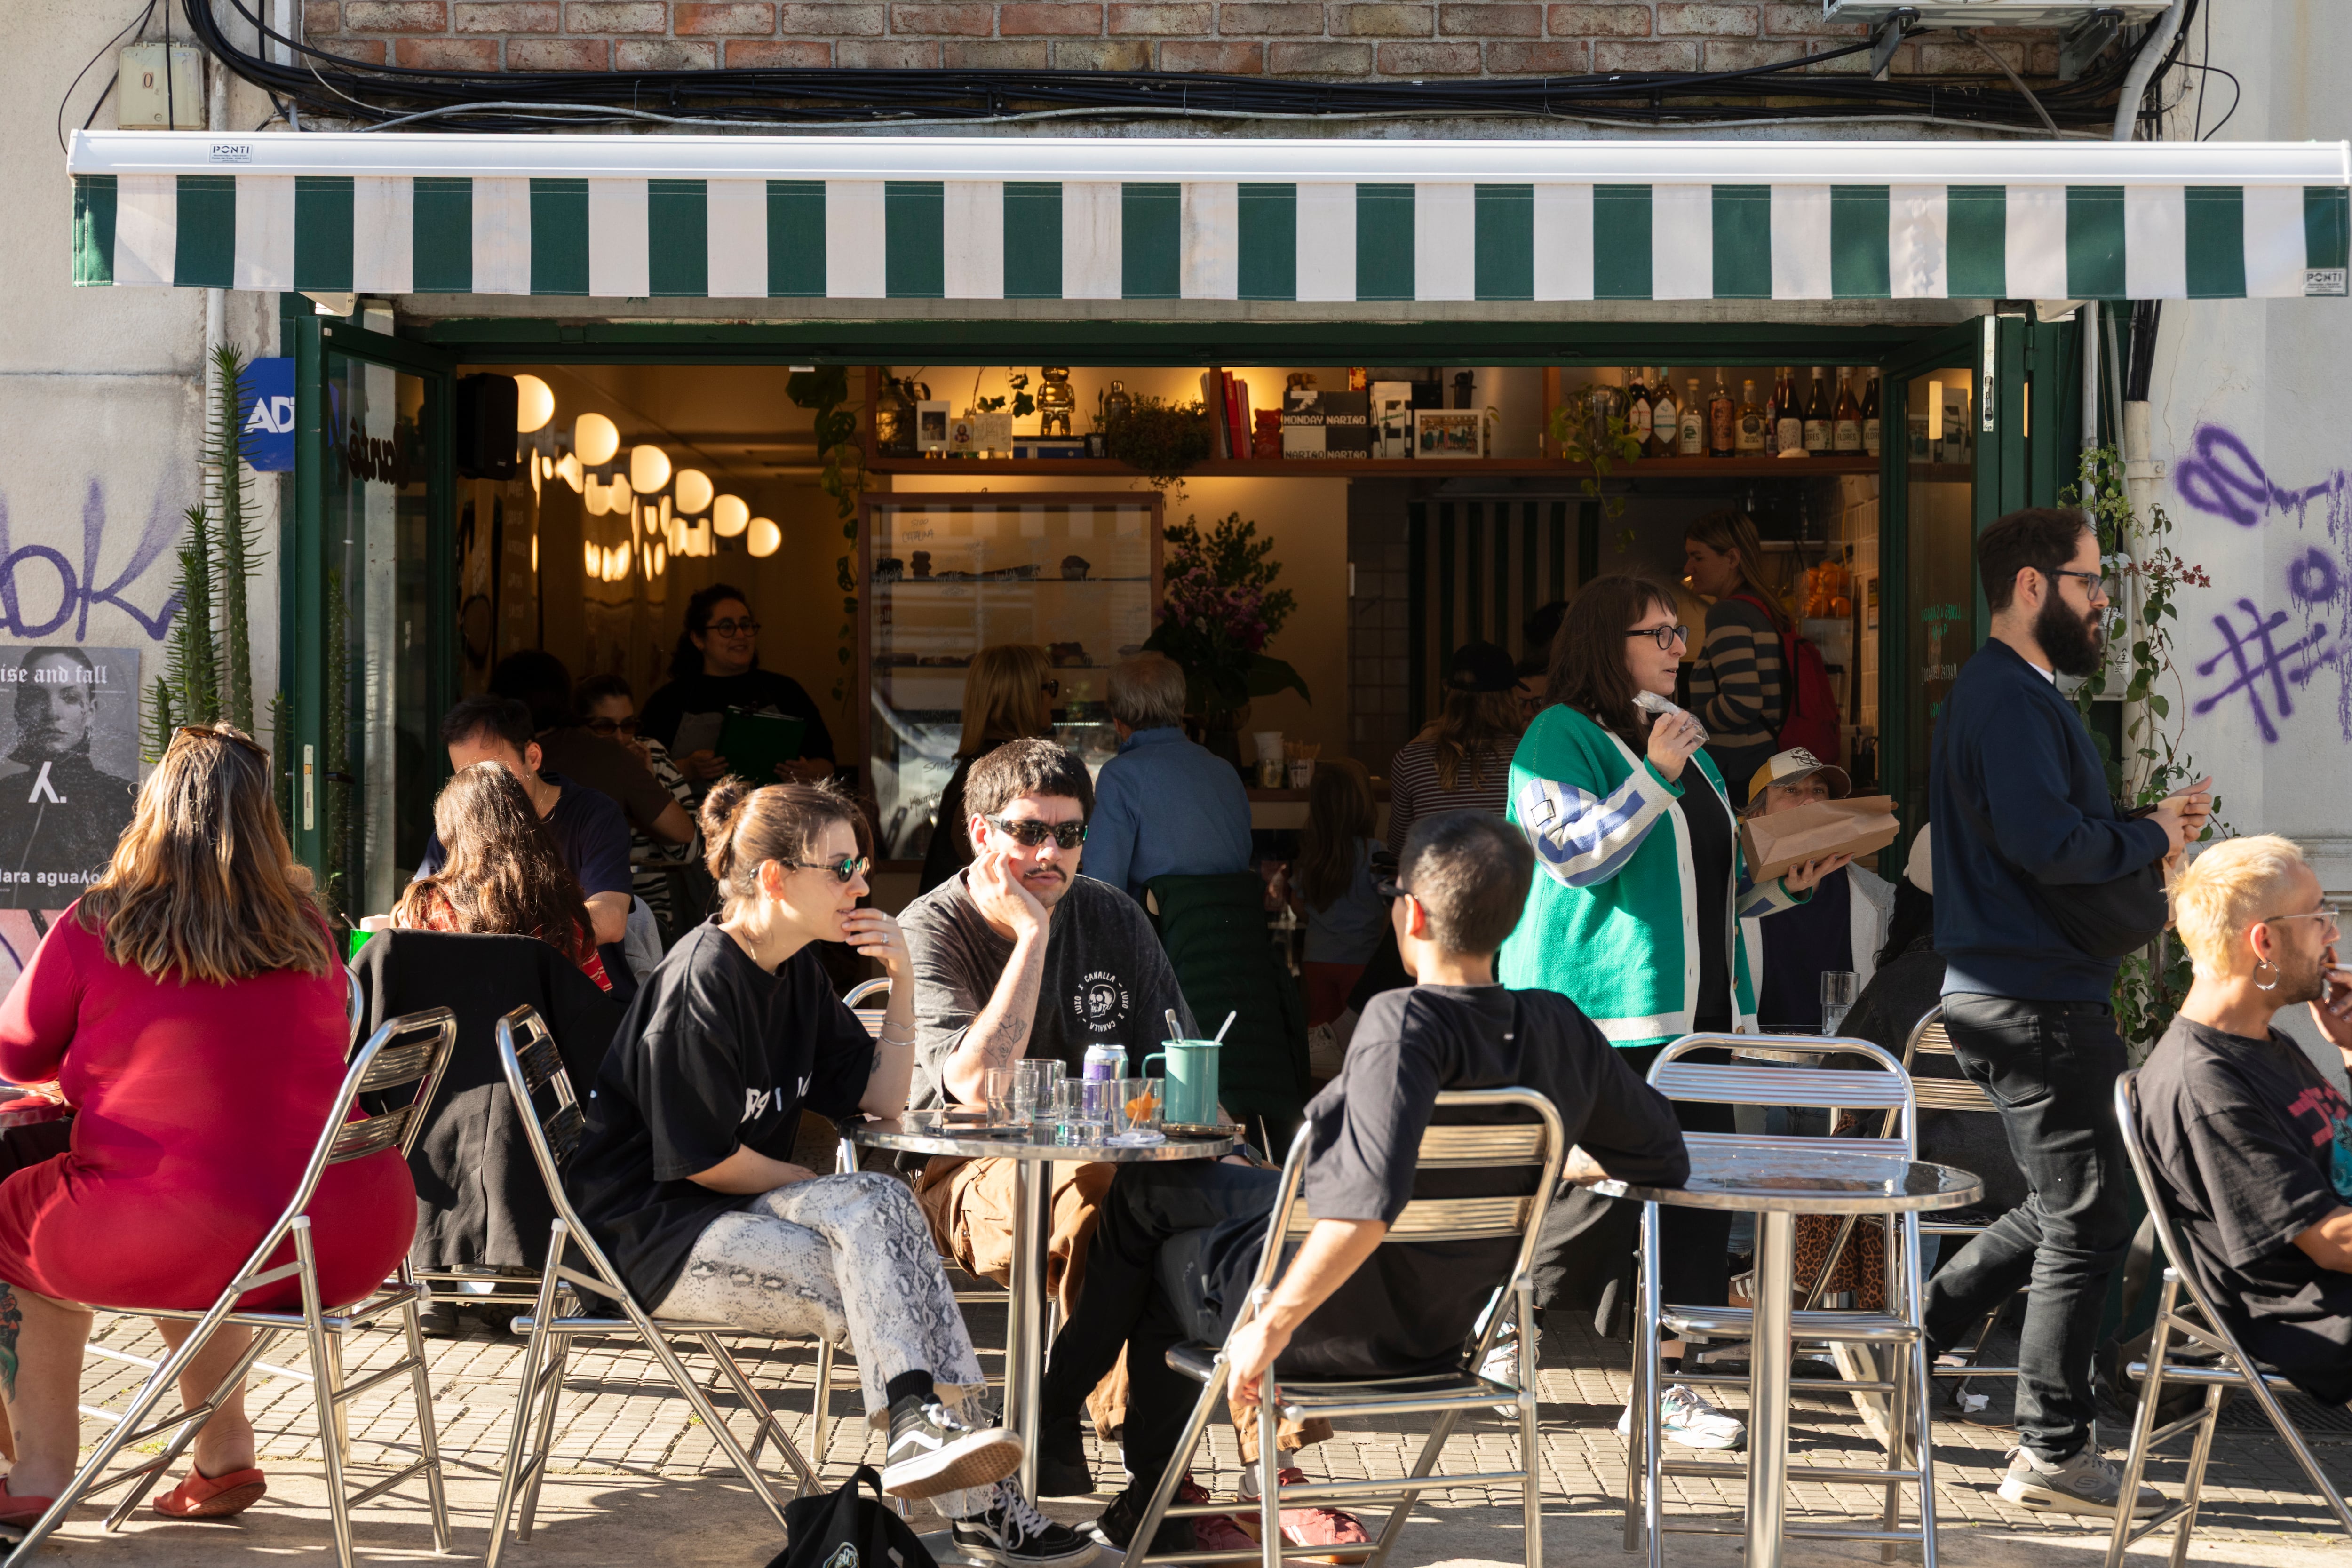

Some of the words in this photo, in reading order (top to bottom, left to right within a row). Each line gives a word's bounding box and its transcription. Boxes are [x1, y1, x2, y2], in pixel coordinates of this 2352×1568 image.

[2306, 273, 2342, 282] PONTI
[243, 396, 294, 433] AD
[1283, 415, 1324, 425] MONDAY
[1326, 415, 1367, 425] NARIÑO
[1837, 433, 1857, 441] FLORES
[1286, 450, 1325, 459] NARIÑO
[1326, 450, 1367, 459] NARIÑO
[33, 665, 69, 683] and
[75, 664, 108, 684] fall
[1084, 971, 1116, 983] CANALLA
[1074, 995, 1083, 1015] LUXO
[1120, 990, 1129, 1009] LUXO
[1089, 1020, 1116, 1032] CANALLA
